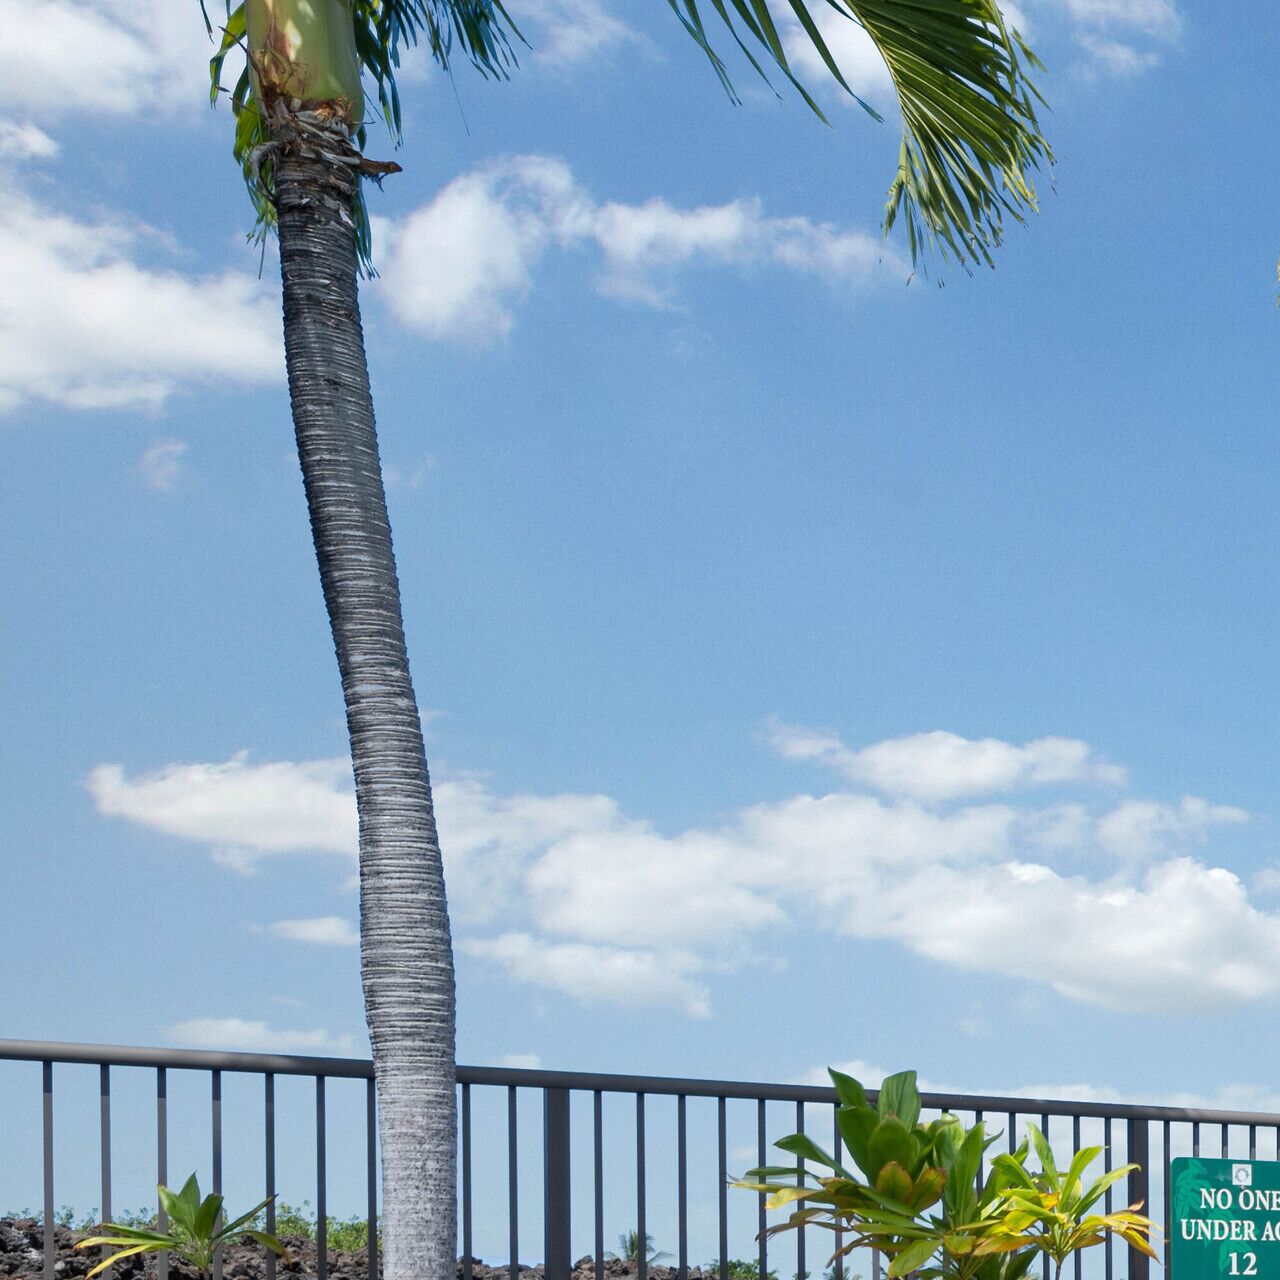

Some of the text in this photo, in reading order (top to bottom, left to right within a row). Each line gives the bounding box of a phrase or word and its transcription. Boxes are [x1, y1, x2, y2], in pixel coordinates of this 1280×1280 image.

[1200, 1188, 1233, 1210] NO
[1180, 1218, 1258, 1241] UNDER
[1228, 1251, 1258, 1276] 12
